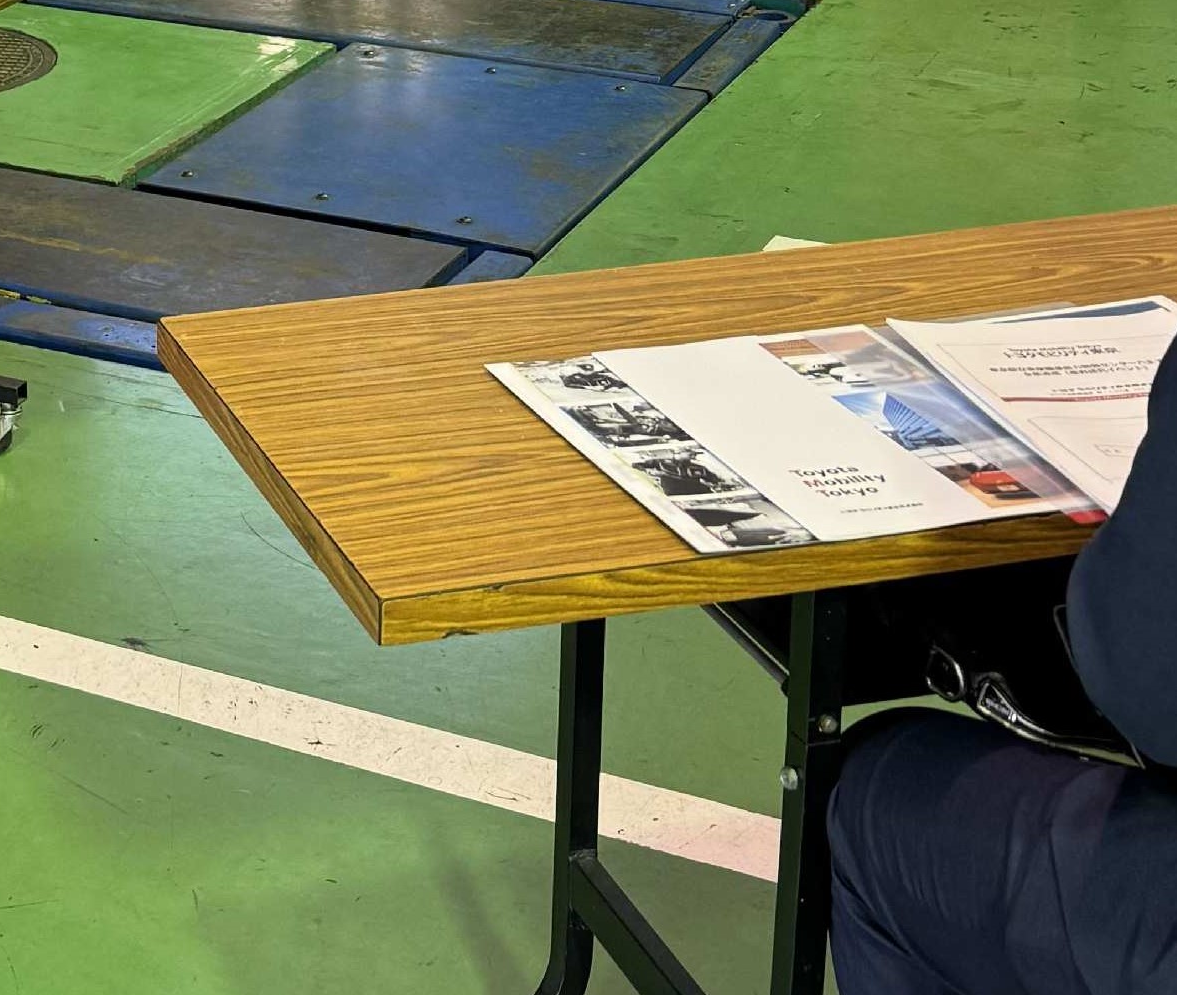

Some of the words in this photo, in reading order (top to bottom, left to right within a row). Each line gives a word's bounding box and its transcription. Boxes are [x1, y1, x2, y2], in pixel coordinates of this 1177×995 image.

[789, 466, 860, 478] Toyota
[802, 473, 887, 489] Mobility
[815, 486, 880, 499] Tokyo
